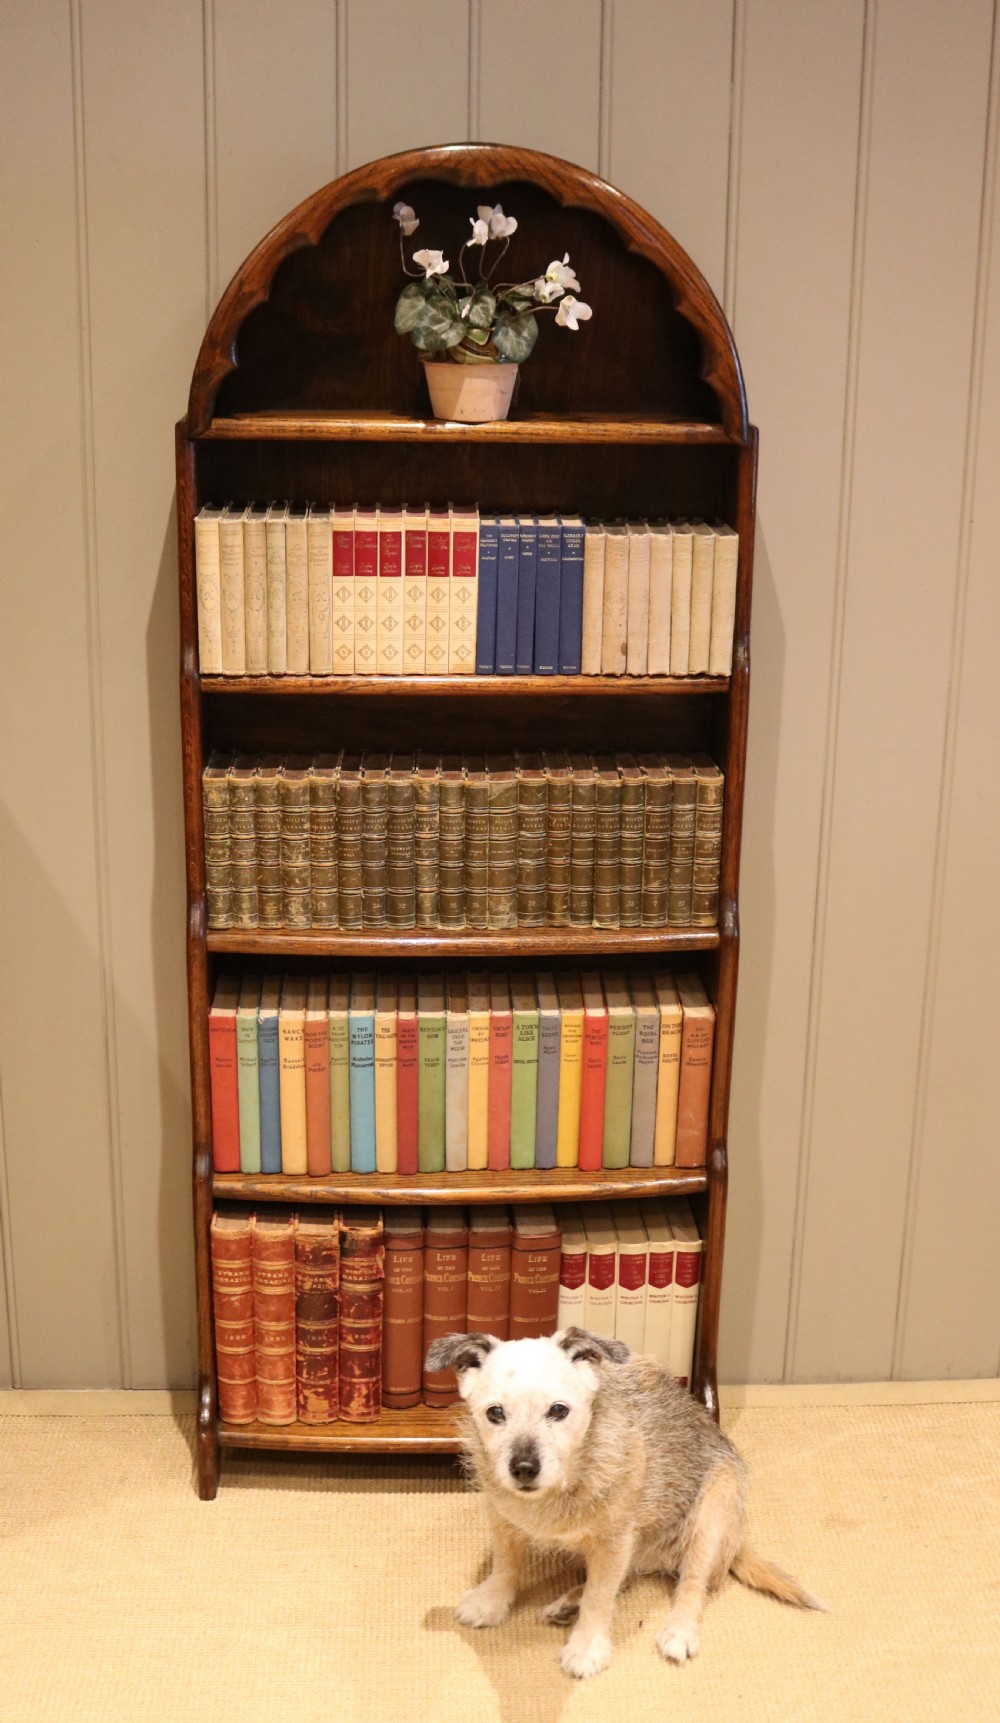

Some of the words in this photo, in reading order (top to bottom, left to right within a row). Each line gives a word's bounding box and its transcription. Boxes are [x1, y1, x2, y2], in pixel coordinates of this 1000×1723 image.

[393, 1255, 413, 1263] LIFE
[436, 1253, 457, 1261] LIFE
[481, 1253, 501, 1261] LIFE
